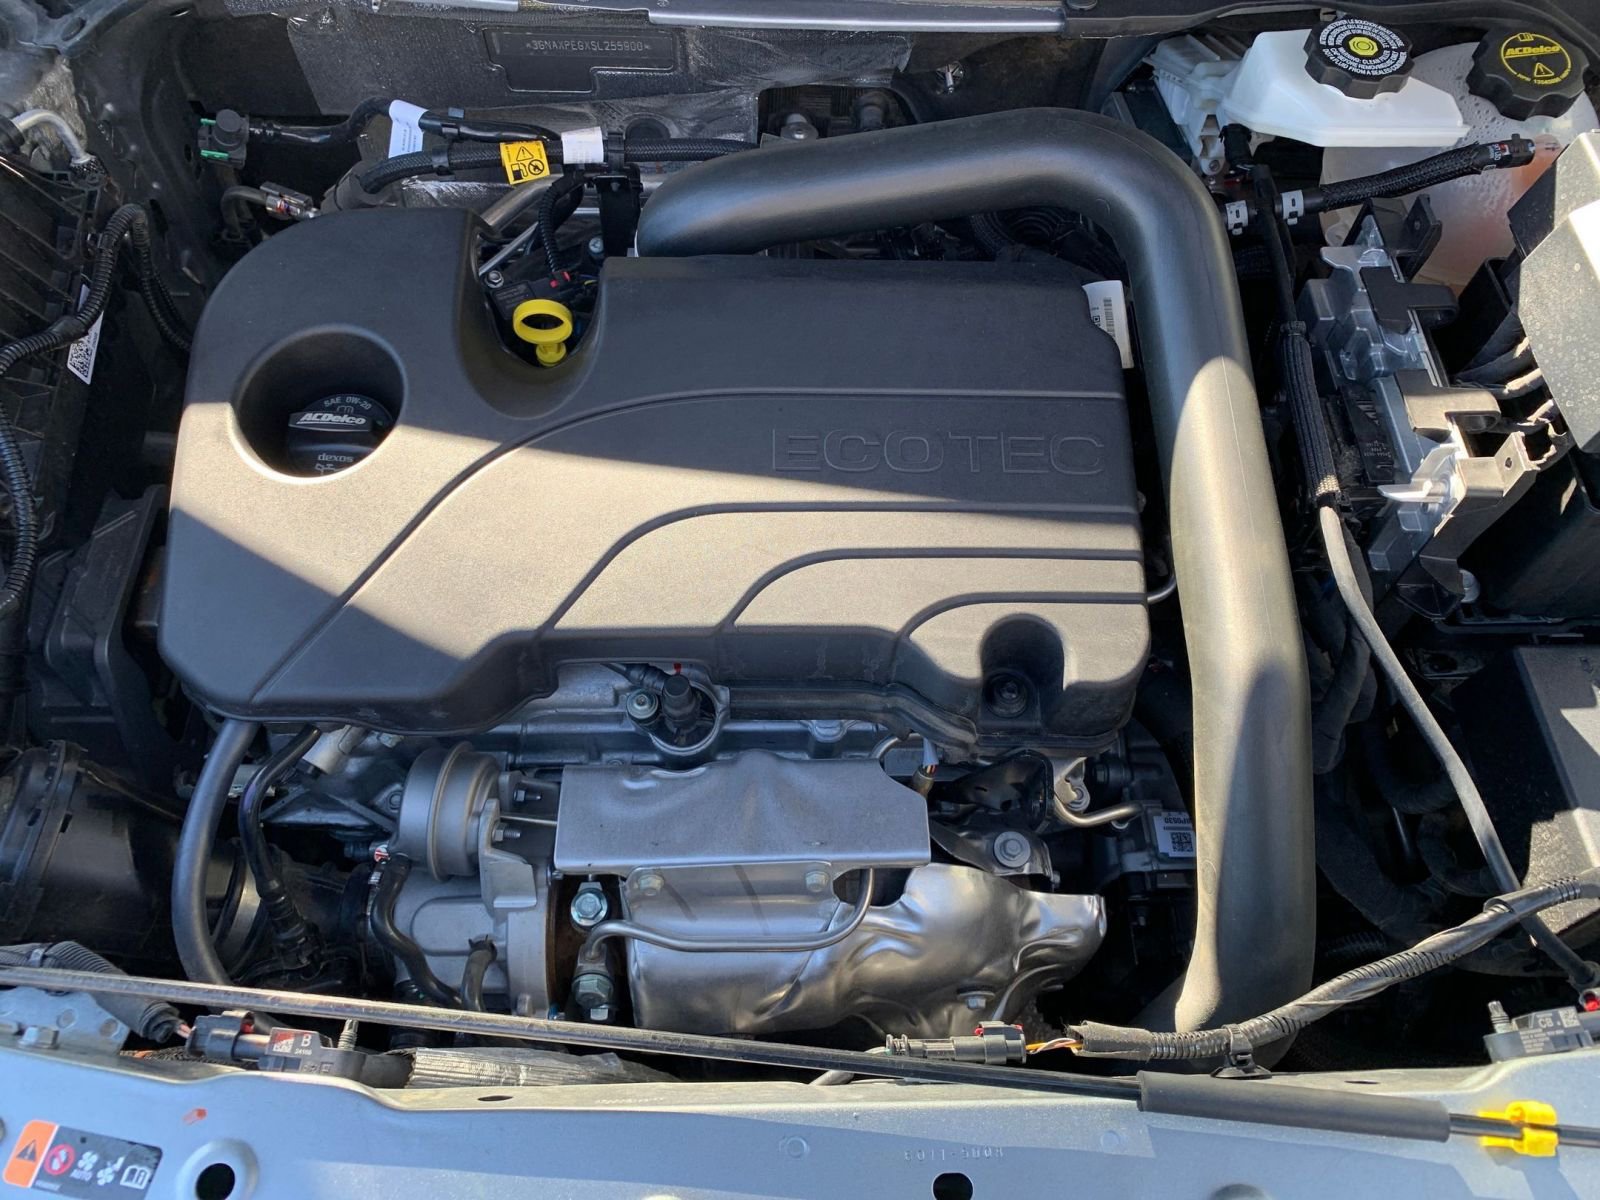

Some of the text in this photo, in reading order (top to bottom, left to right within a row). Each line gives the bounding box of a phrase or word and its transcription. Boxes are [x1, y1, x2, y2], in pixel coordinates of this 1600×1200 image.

[1506, 46, 1560, 56] ACDelco
[324, 397, 372, 410] SAE 0W-20
[299, 413, 367, 425] ACDelco
[318, 453, 354, 463] dexos
[772, 429, 1105, 475] ECOTEC
[301, 1033, 312, 1046] B
